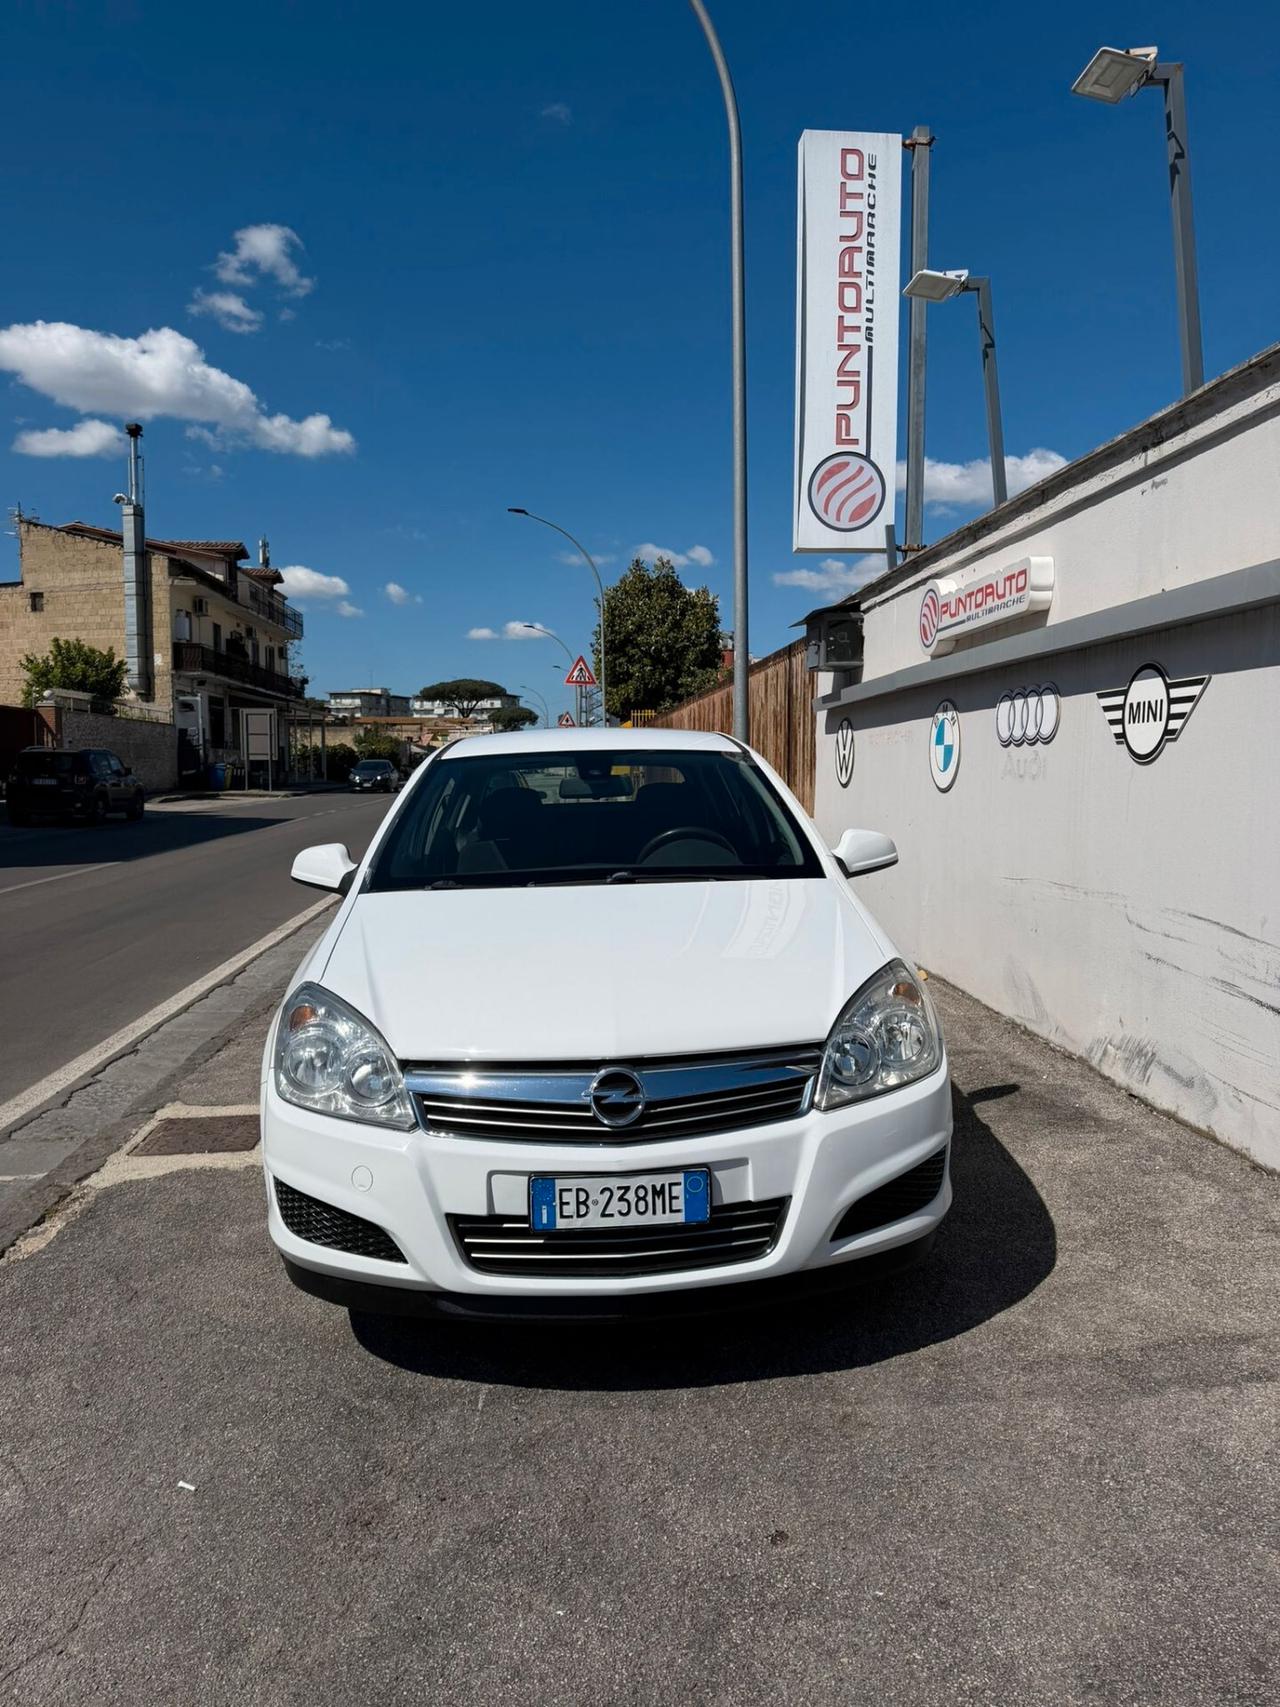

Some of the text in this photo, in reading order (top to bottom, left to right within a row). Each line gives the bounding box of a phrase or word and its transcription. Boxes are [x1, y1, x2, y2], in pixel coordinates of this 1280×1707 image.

[836, 148, 864, 445] PUNTOAUTO
[865, 153, 877, 342] MULTIMARCHE
[940, 568, 1027, 622] PUNTOAUTO
[1128, 699, 1163, 724] MINI
